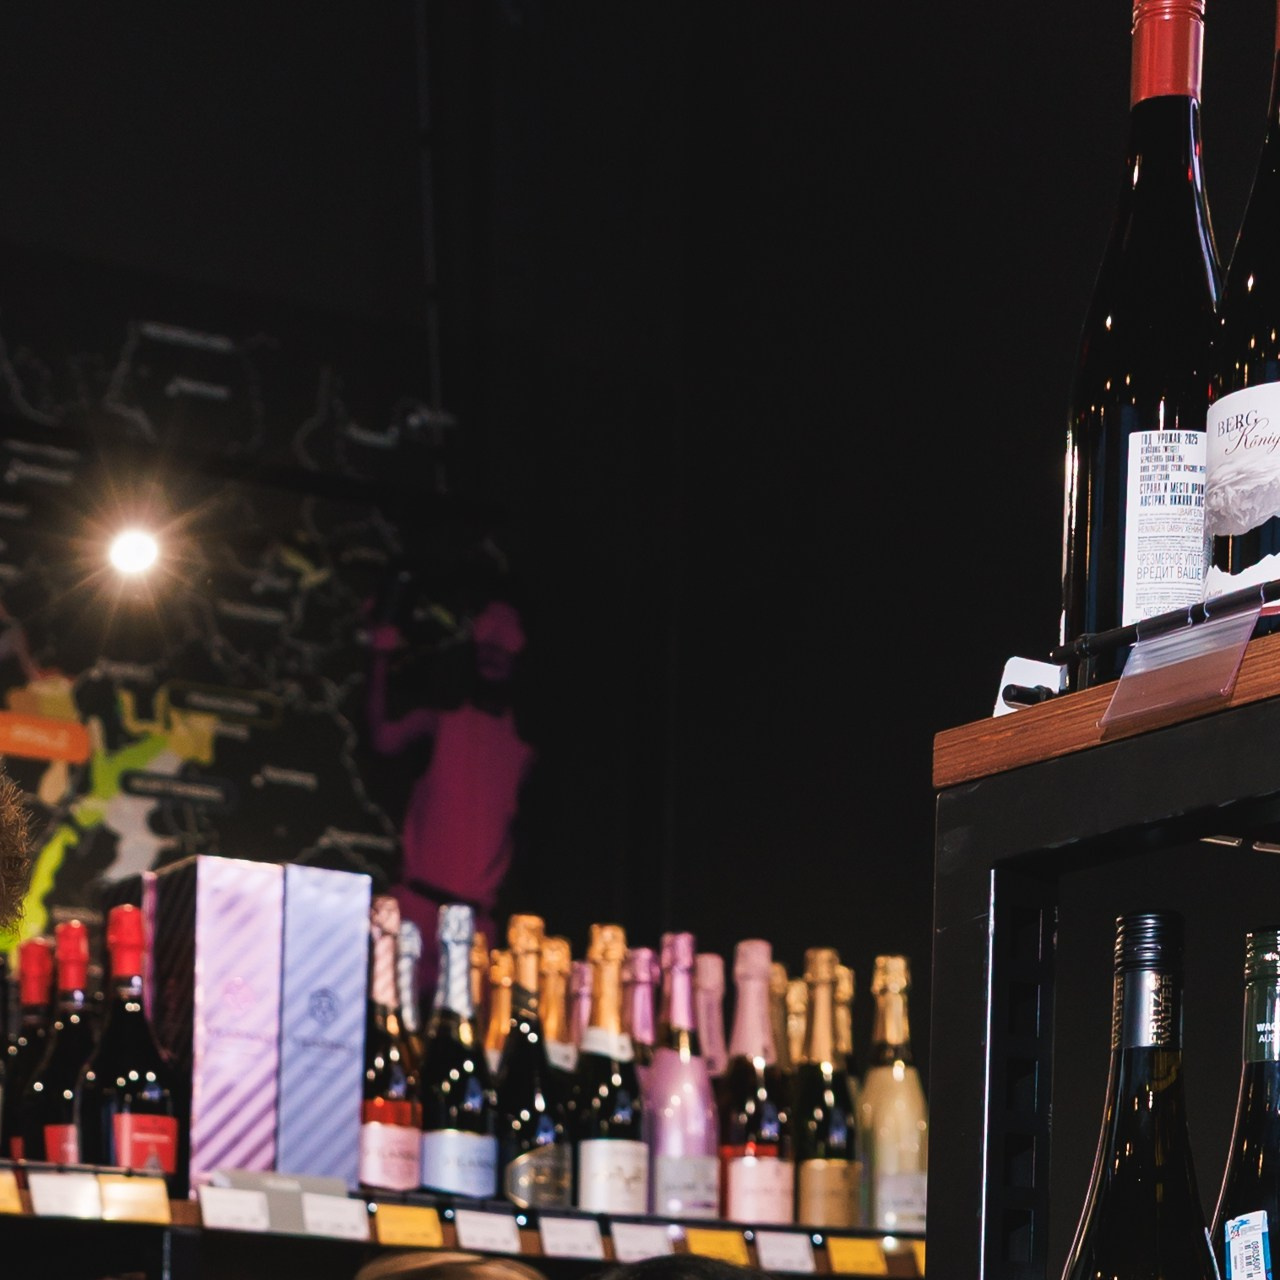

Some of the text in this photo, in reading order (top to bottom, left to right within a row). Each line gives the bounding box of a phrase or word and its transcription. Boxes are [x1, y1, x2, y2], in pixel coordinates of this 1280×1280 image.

[1217, 410, 1259, 437] BERG
[1140, 483, 1161, 495] СТРАНА
[1170, 482, 1189, 494] МЕСТО
[1137, 553, 1183, 566] ЧРЕЗМЕРНОЕ
[1137, 566, 1174, 580] ВРЕДИТ
